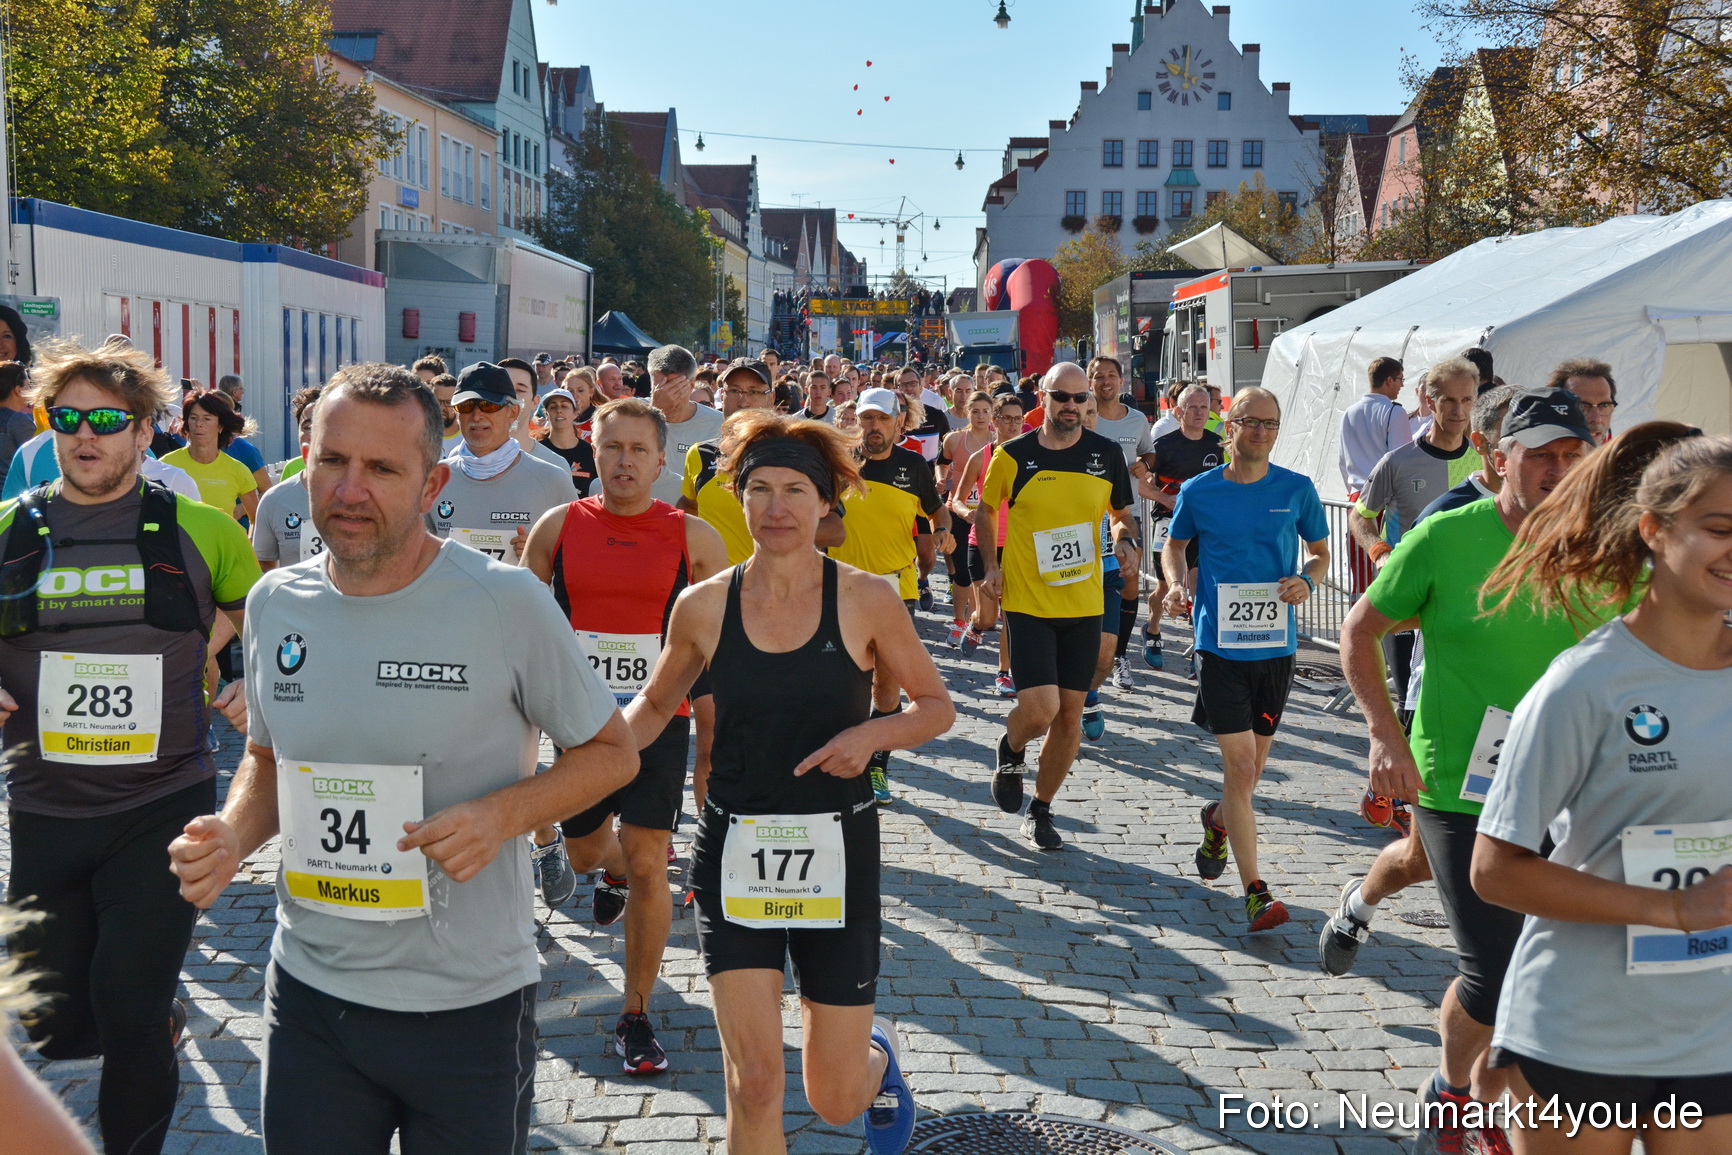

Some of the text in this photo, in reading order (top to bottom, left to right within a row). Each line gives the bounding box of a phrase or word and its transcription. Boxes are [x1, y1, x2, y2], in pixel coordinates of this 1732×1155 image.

[842, 302, 876, 312] START
[677, 443, 690, 453] BO
[490, 511, 531, 521] BOCK
[470, 534, 502, 543] BOCK
[1052, 530, 1077, 540] BOCK
[1161, 527, 1169, 538] 2
[310, 536, 322, 555] 3
[1051, 540, 1081, 562] 231
[1060, 568, 1081, 578] Vlatko
[1239, 589, 1269, 597] BOCK
[49, 600, 67, 611] by
[71, 598, 116, 609] smart
[120, 597, 145, 606] con
[1229, 601, 1278, 622] 2373
[1237, 632, 1270, 641] Andreas
[598, 641, 636, 651] BOCK
[74, 663, 128, 675] BOCK
[377, 661, 469, 684] BOCK
[274, 682, 304, 694] PARTL
[376, 681, 403, 689] inspired
[66, 683, 133, 718] 283
[273, 694, 304, 702] Neumarkt
[67, 736, 130, 751] Christian
[1487, 739, 1505, 765] 2
[1628, 751, 1677, 764] PARTL
[1629, 763, 1678, 773] Neumarkt
[313, 777, 375, 796] BOCK
[320, 807, 370, 855] 34
[756, 826, 809, 839] BOCK
[288, 838, 294, 847] C
[307, 858, 377, 872] PARTL Neumarkt
[751, 848, 815, 881] 177
[317, 880, 380, 903] Markus
[764, 901, 804, 918] Birgit
[1687, 935, 1728, 956] Rosa
